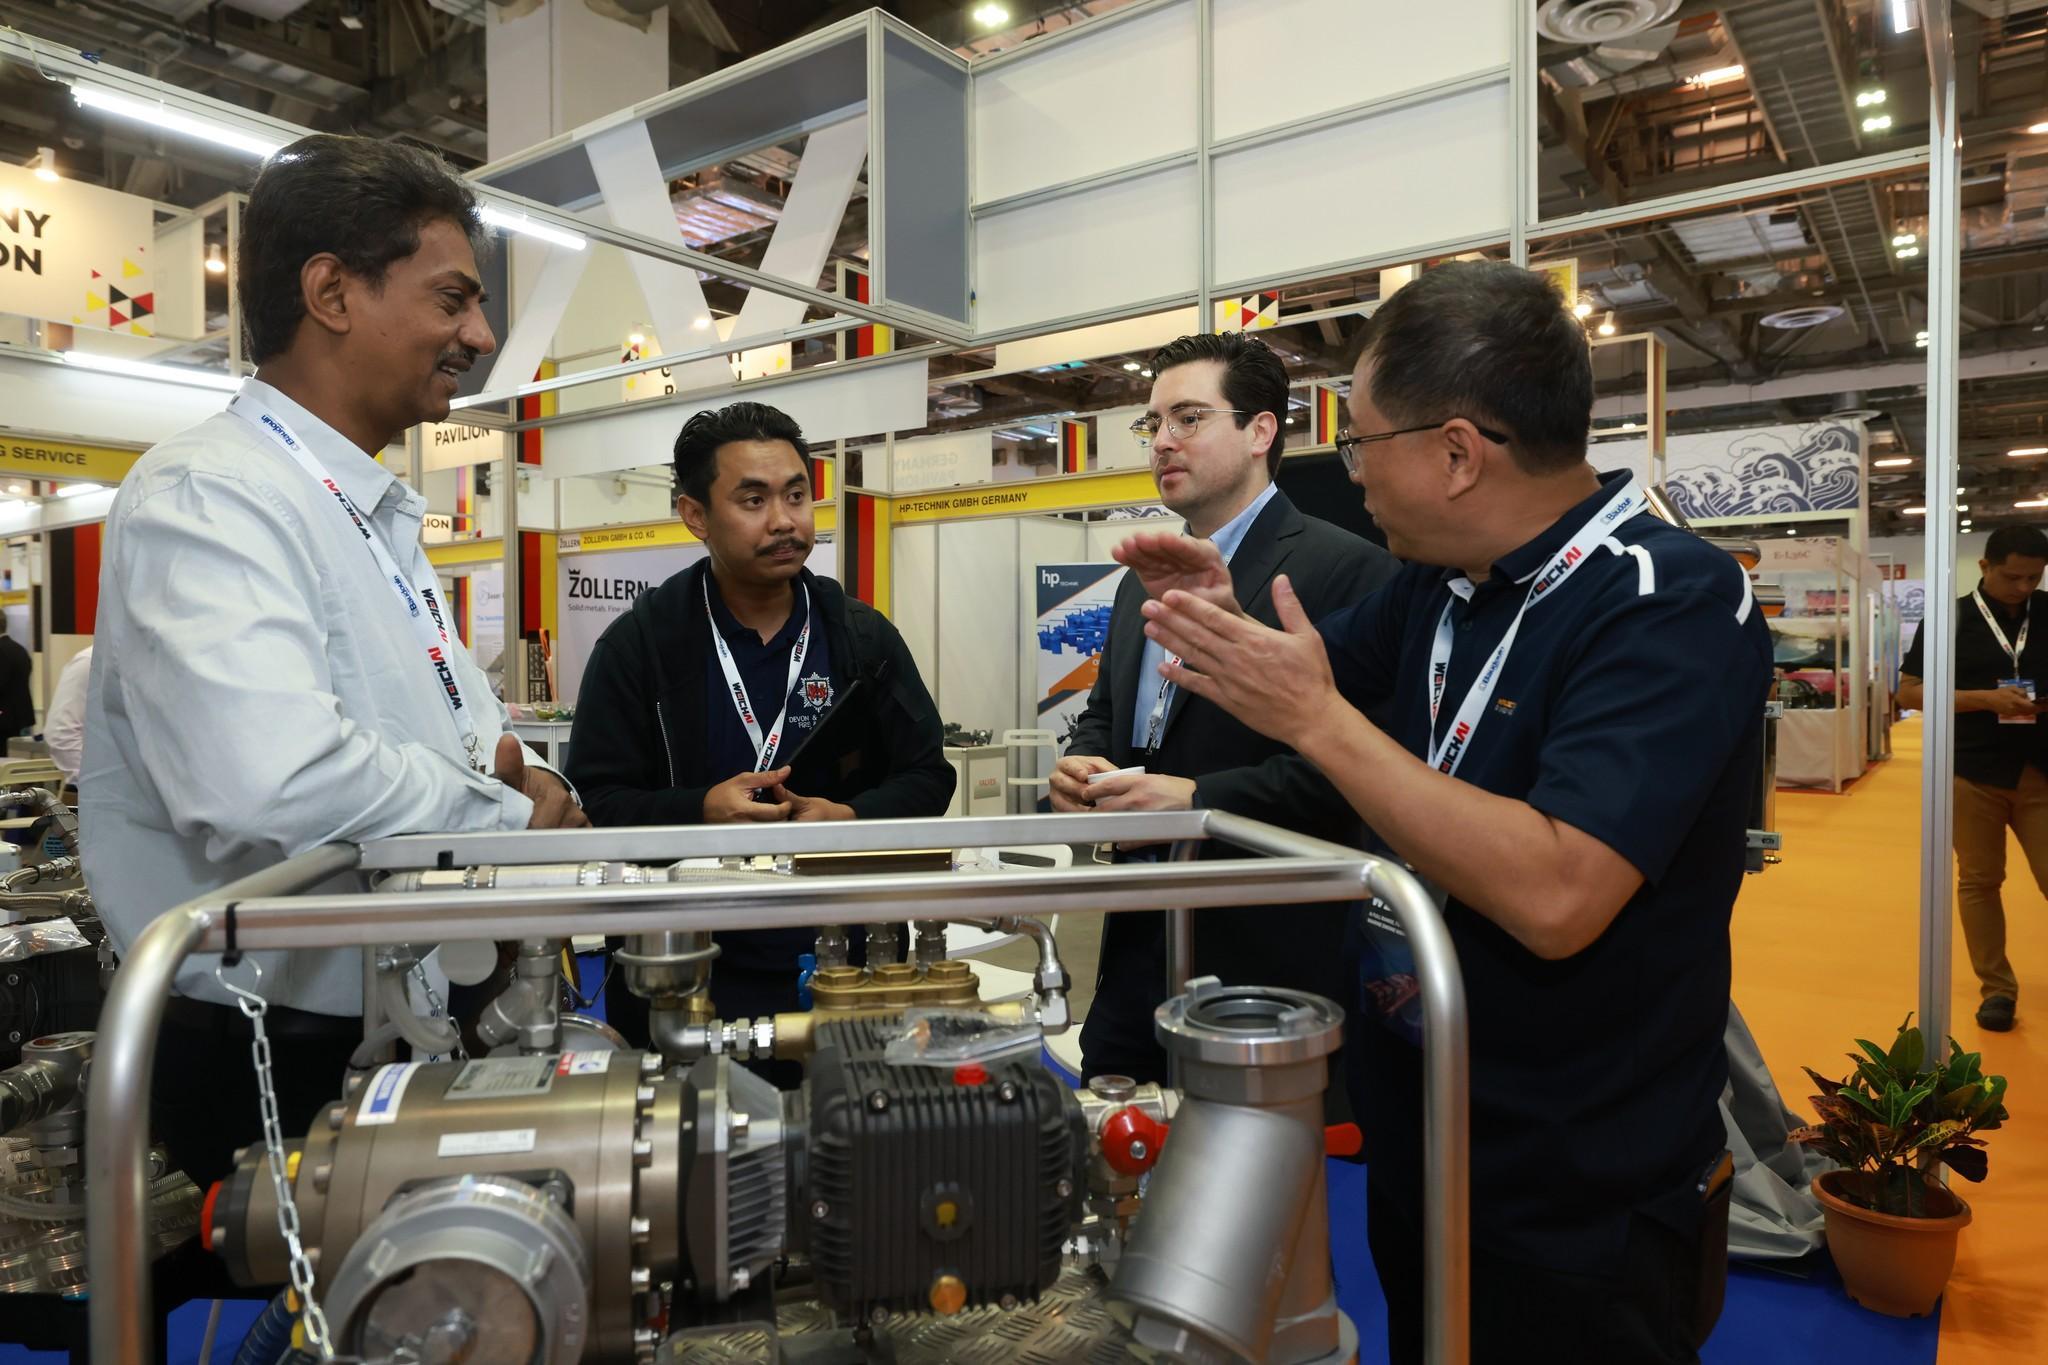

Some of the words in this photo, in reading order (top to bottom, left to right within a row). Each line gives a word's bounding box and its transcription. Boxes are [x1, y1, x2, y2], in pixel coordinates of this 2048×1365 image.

[261, 414, 295, 446] Baudouin
[435, 426, 490, 446] PAVILION
[12, 447, 87, 465] SERVICE
[323, 479, 371, 540] WEICHAI
[899, 501, 950, 513] HP-TECHNIK
[952, 498, 979, 508] GMBH
[981, 492, 1028, 505] GERMANY
[1042, 569, 1060, 588] hp
[421, 588, 449, 643] WEICHAI
[427, 647, 463, 710] WEICHAI
[732, 682, 754, 724] WEICHAI
[789, 715, 810, 723] DEVON
